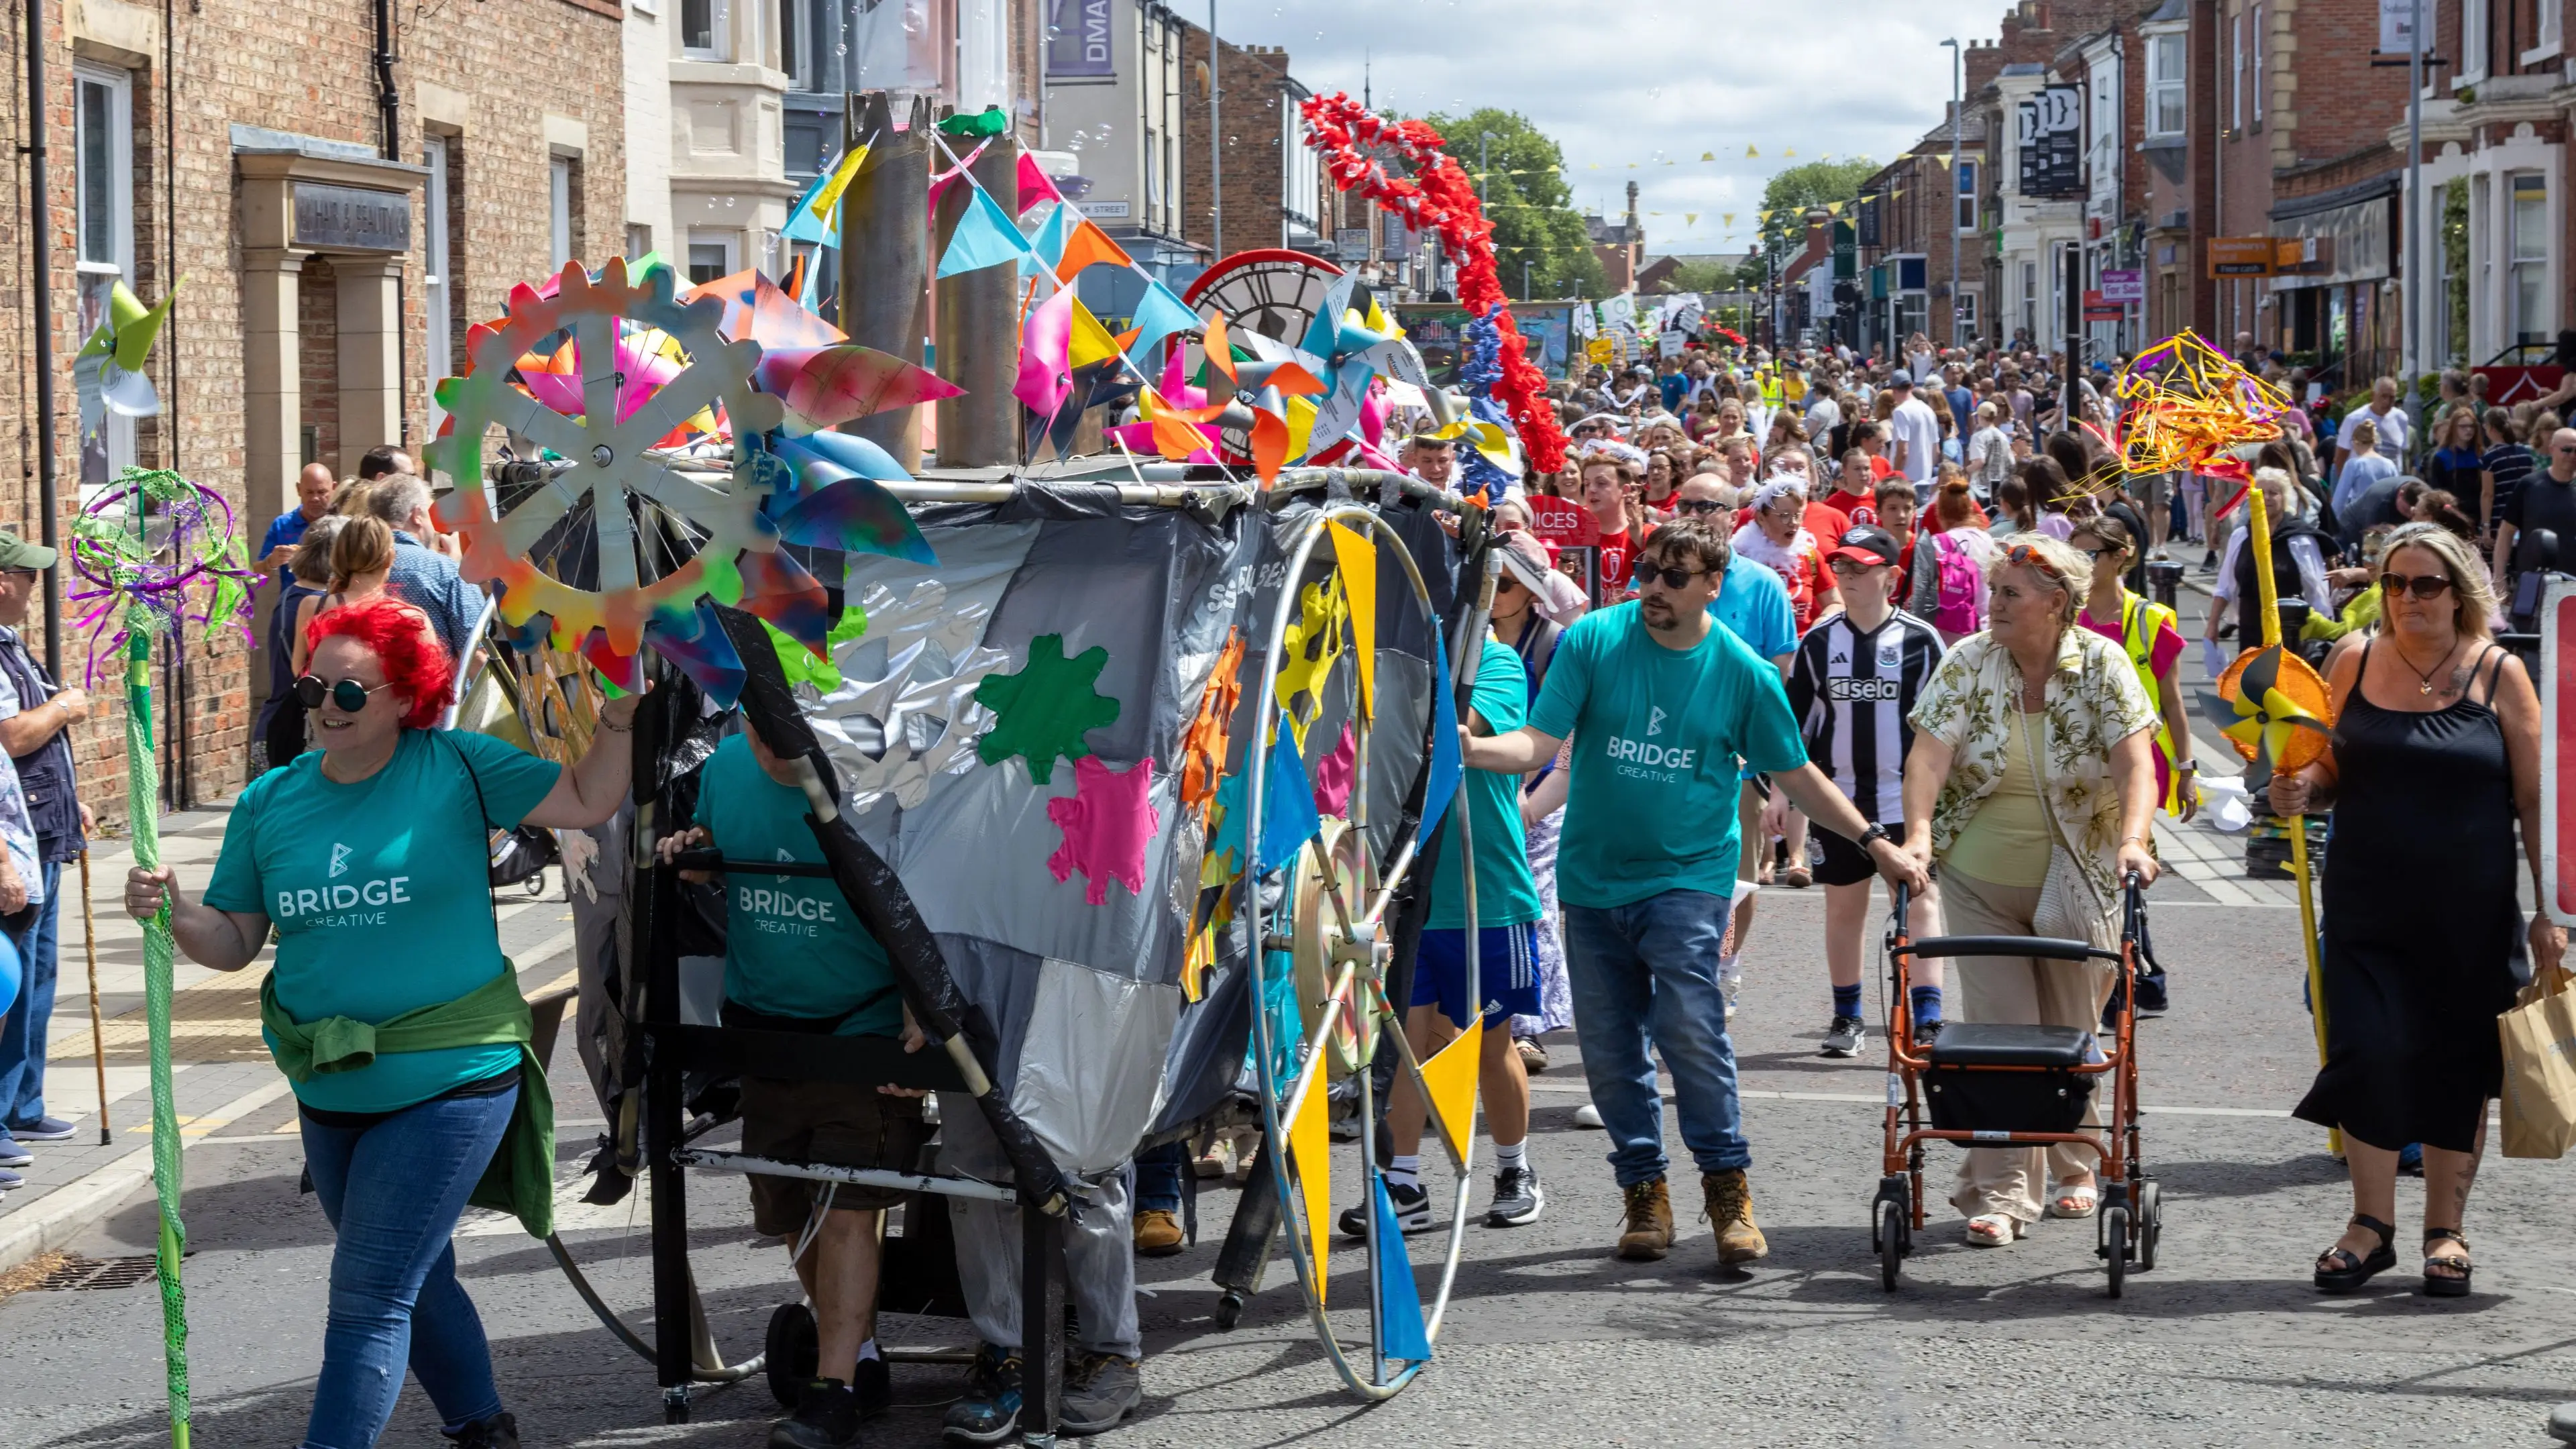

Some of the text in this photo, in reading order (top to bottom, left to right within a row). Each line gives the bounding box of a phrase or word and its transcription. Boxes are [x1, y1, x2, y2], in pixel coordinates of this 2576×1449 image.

[1085, 0, 1107, 62] DMA
[315, 200, 339, 231] HAIR
[356, 204, 394, 236] BEAUTY
[1094, 205, 1126, 213] STREET
[2105, 284, 2119, 295] For
[1536, 512, 1578, 528] ICES
[1849, 678, 1898, 699] sela
[1606, 735, 1696, 769] BRIDGE
[1617, 765, 1676, 783] CREATIVE
[278, 876, 411, 917] BRIDGE
[740, 886, 836, 922] BRIDGE
[305, 912, 386, 927] CREATIVE
[754, 919, 818, 937] CREATIVE
